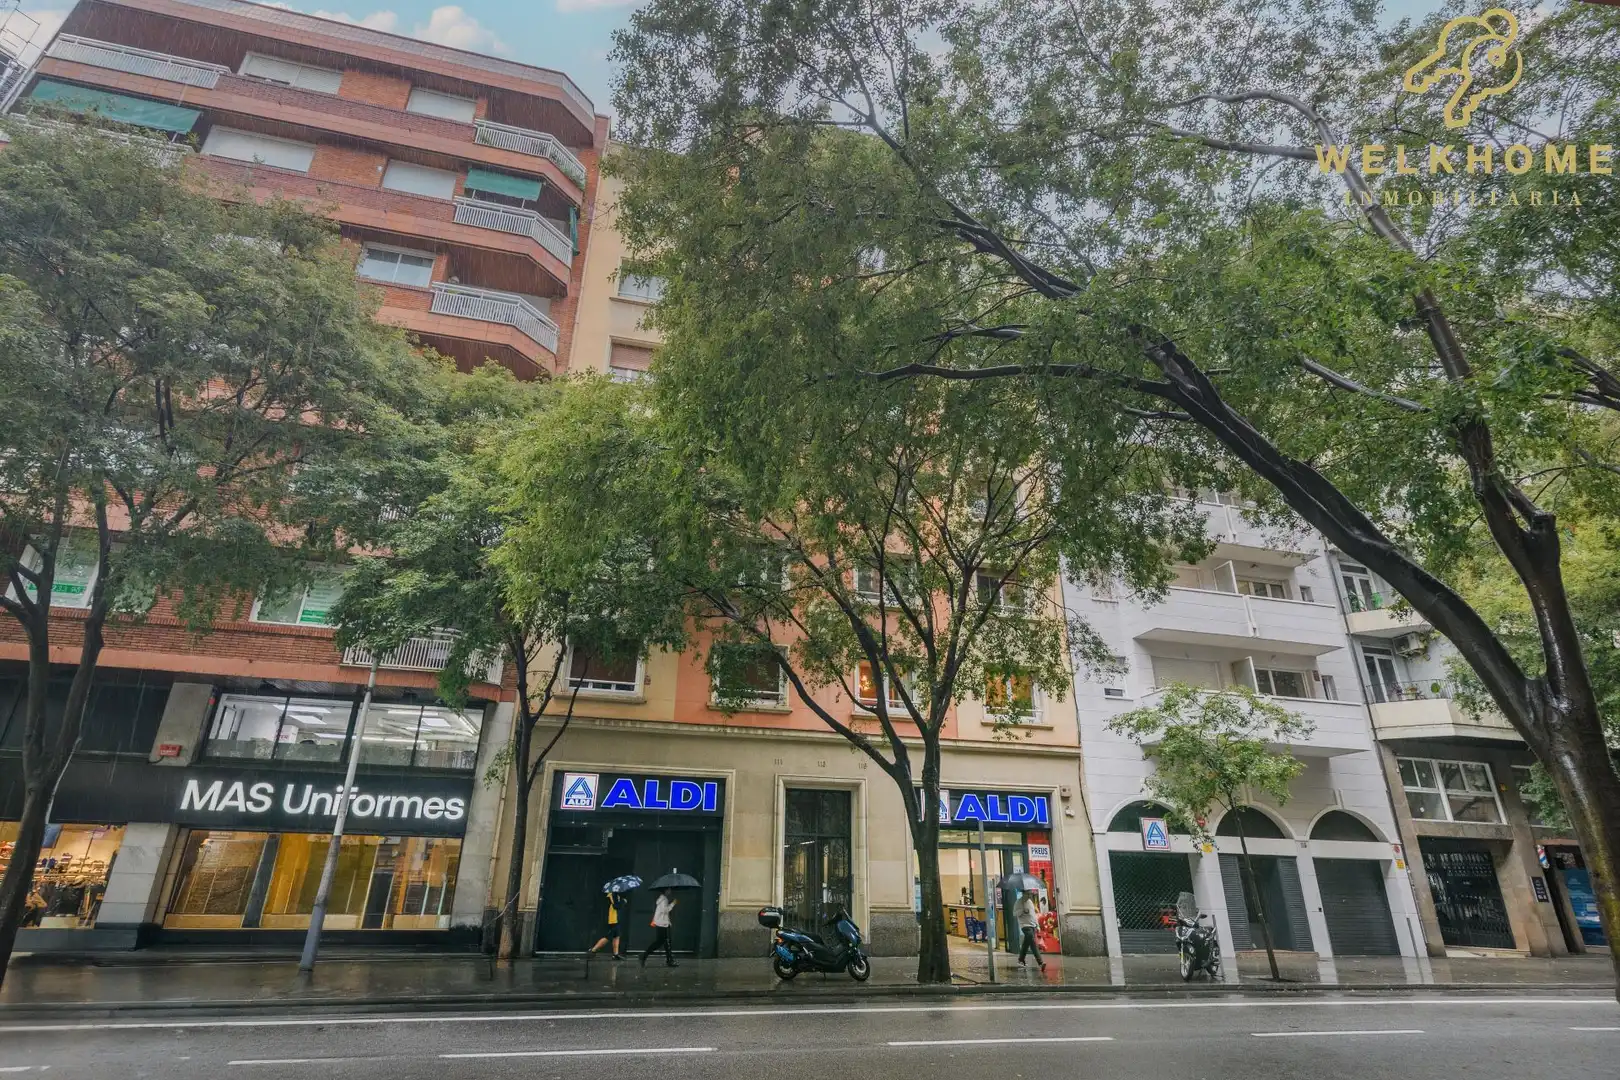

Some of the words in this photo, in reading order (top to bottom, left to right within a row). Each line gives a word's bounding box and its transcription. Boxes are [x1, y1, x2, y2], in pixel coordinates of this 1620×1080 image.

[180, 779, 273, 813] MAS
[567, 798, 591, 806] ALDI
[601, 778, 717, 811] ALDI
[953, 793, 1048, 824] ALDI
[1031, 847, 1048, 855] PREUS
